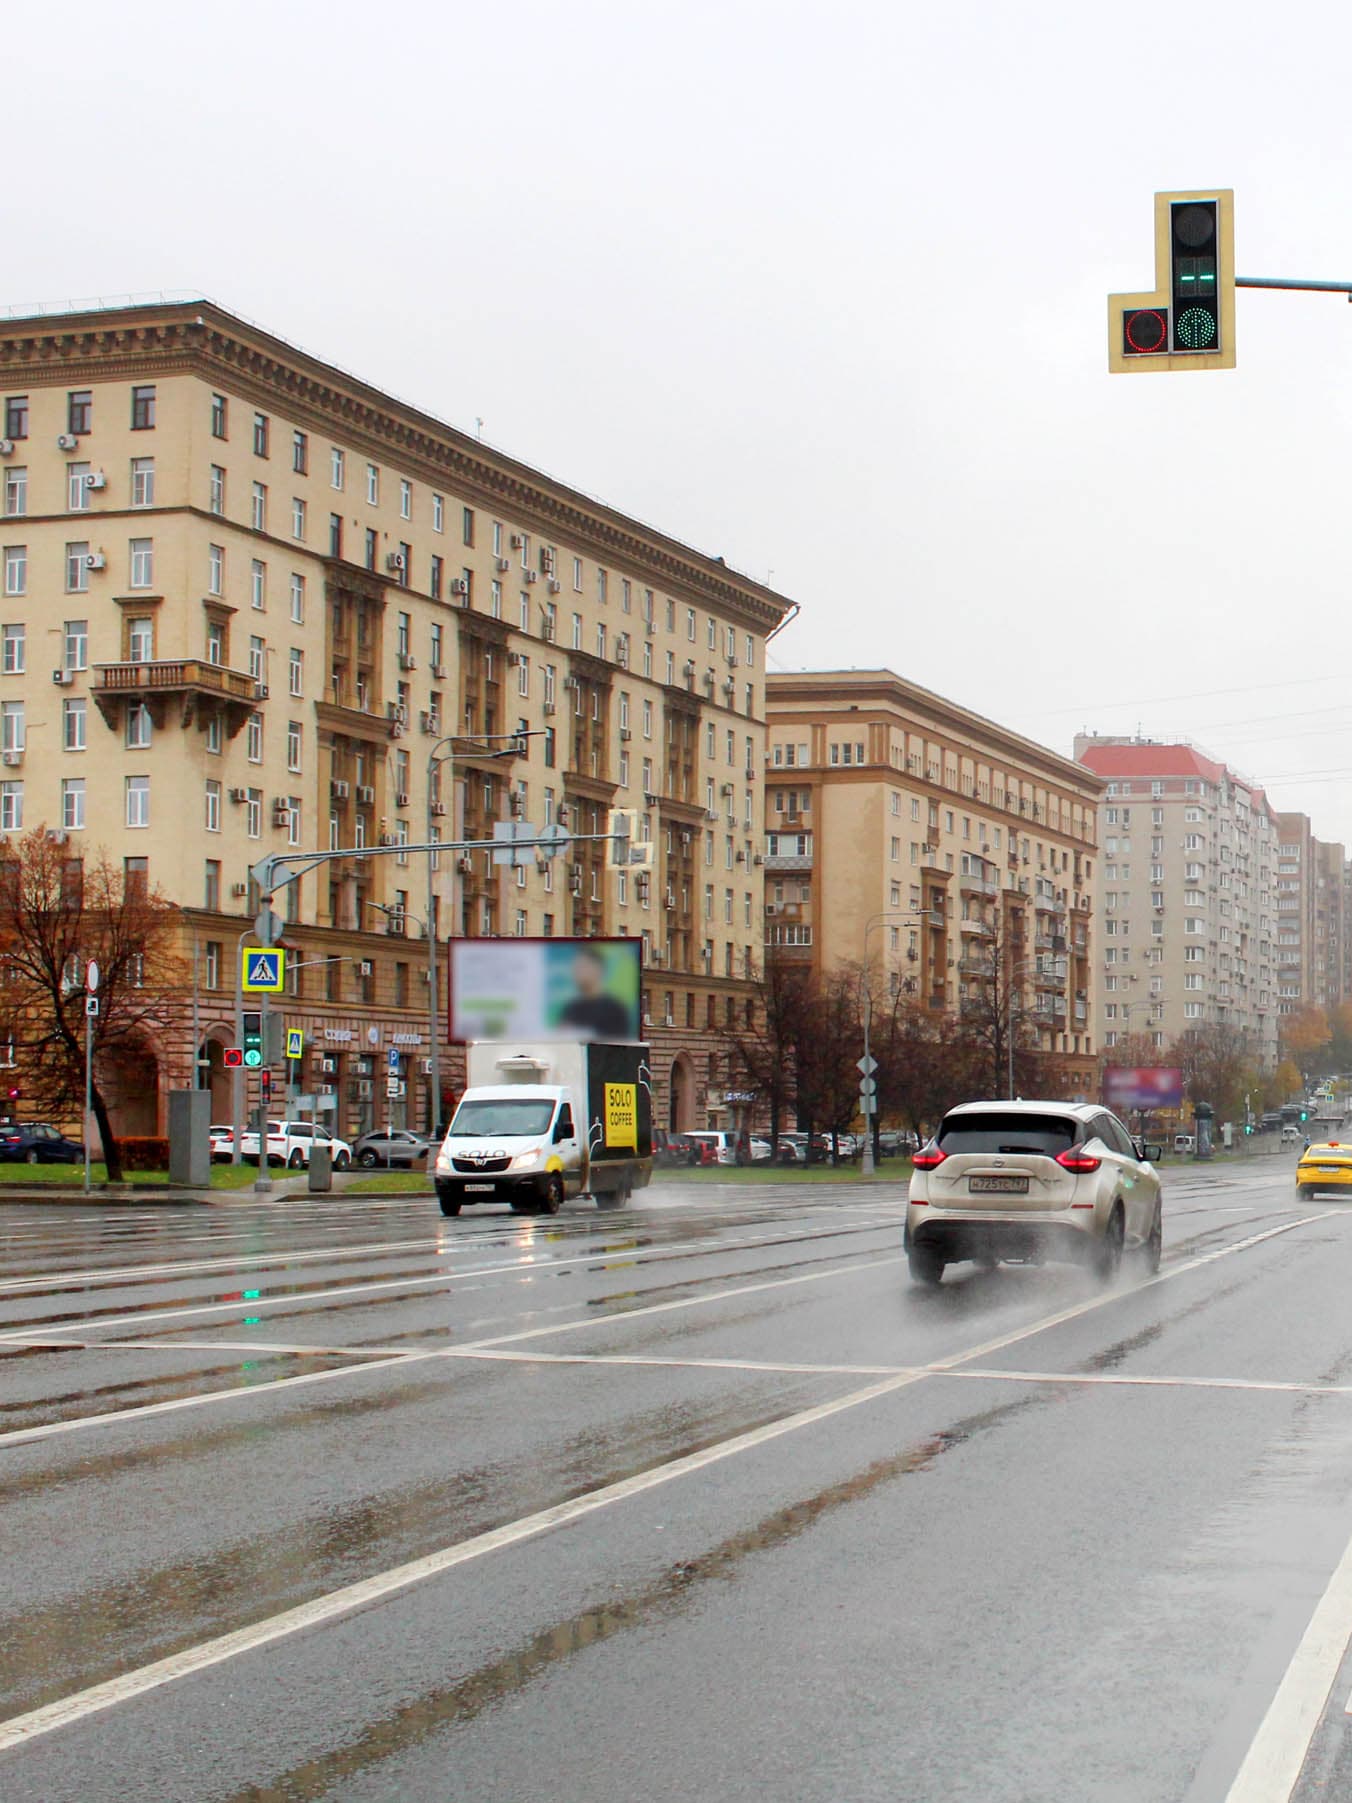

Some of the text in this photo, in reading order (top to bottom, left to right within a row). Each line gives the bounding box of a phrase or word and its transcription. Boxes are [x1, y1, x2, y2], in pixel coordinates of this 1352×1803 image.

[609, 1088, 632, 1107] SOLO
[610, 1112, 632, 1126] COFFEE
[458, 1149, 507, 1158] SOLO
